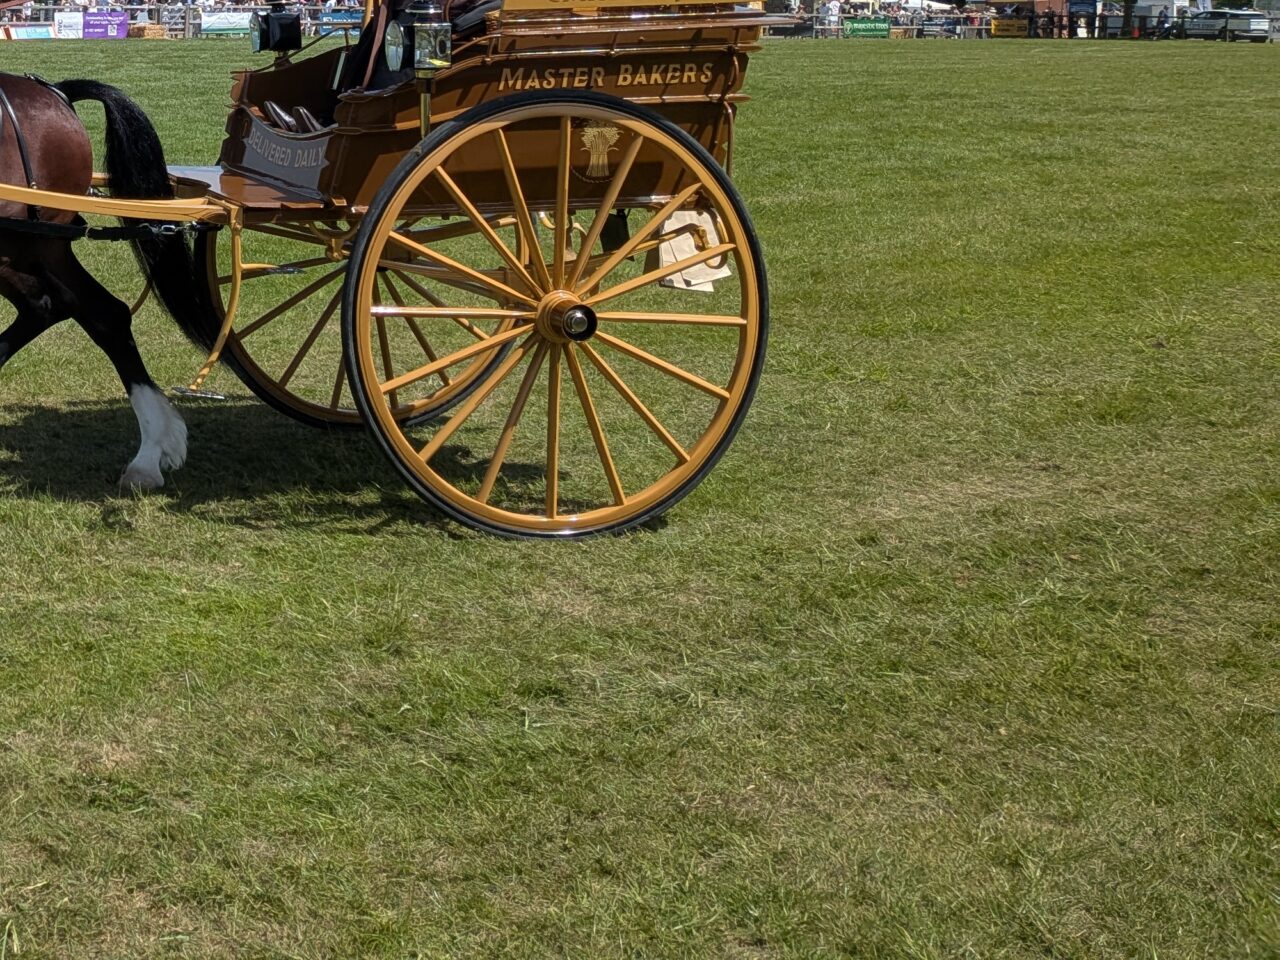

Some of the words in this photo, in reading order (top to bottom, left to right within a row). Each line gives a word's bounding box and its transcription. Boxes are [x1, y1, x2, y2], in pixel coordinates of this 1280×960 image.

[498, 66, 605, 90] MASTER
[617, 62, 713, 86] BAKERS
[248, 127, 291, 167] DELIVERED
[295, 145, 326, 168] DAILY
